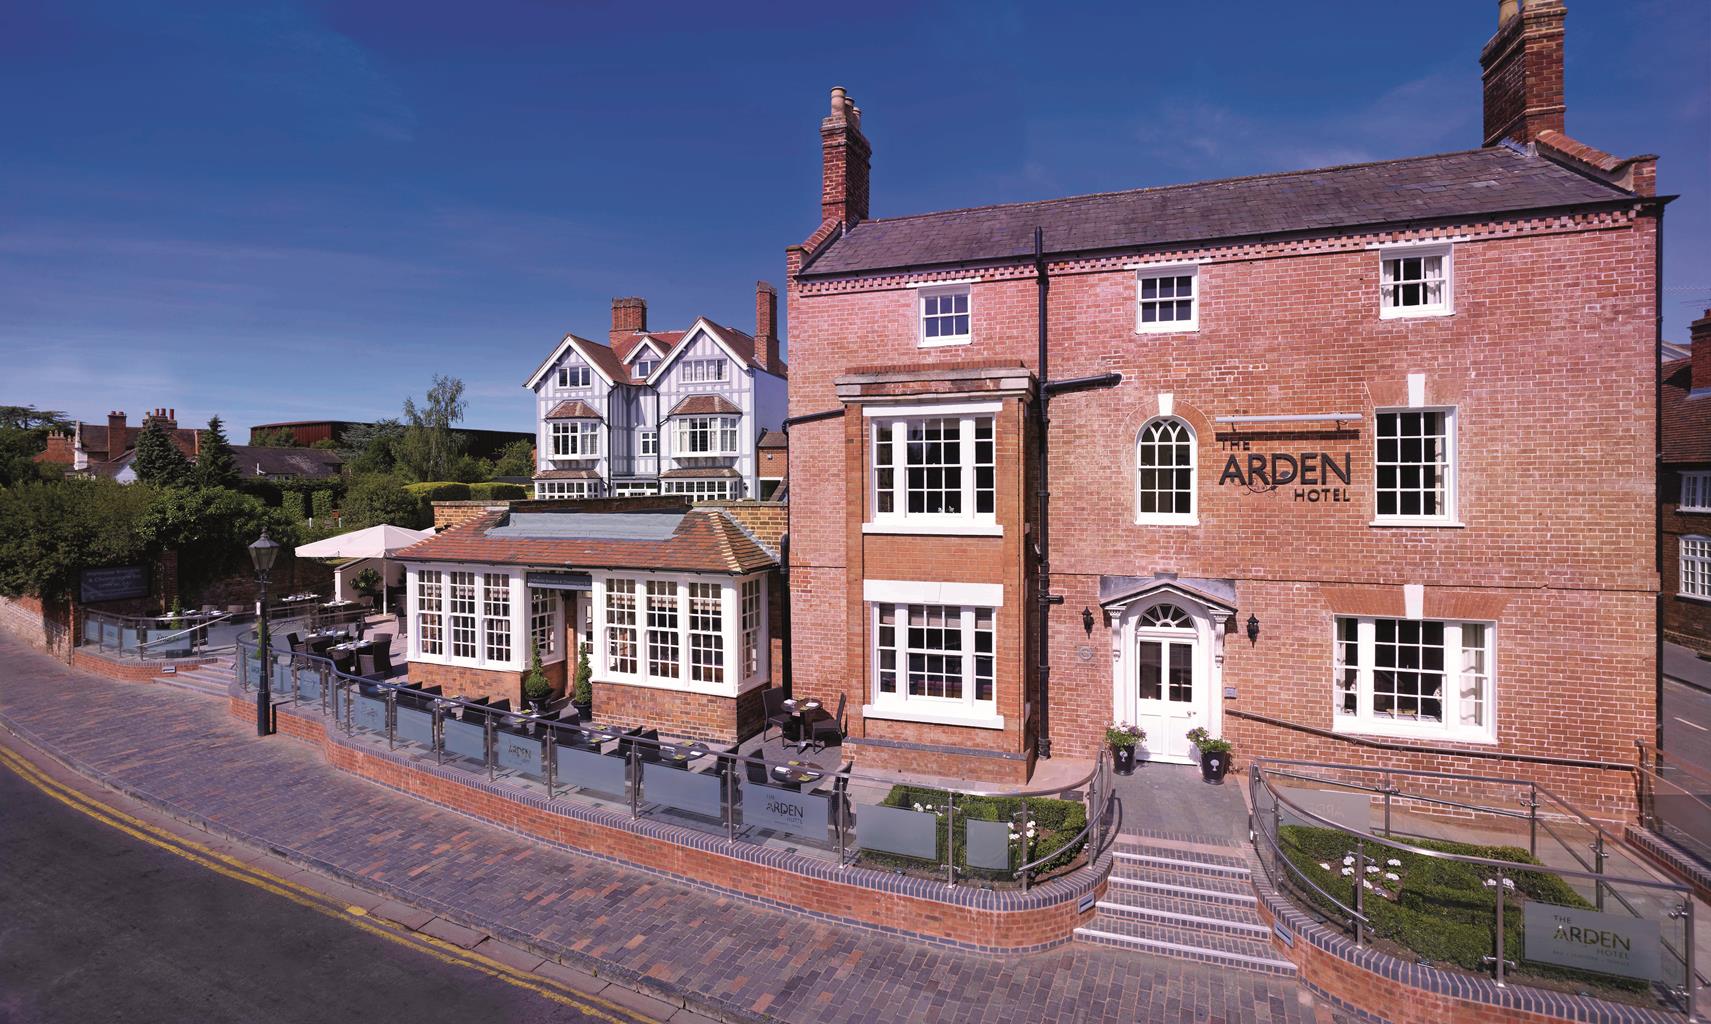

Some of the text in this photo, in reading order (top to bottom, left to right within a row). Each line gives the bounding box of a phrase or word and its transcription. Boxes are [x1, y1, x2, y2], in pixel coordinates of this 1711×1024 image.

[1221, 440, 1251, 451] THE
[1218, 451, 1352, 486] ARDEN
[1294, 488, 1351, 503] HOTEL
[766, 802, 804, 818] ARDEN
[1553, 914, 1572, 925] THE
[1552, 924, 1631, 952] ARDEN
[1596, 948, 1630, 960] HOTEL
